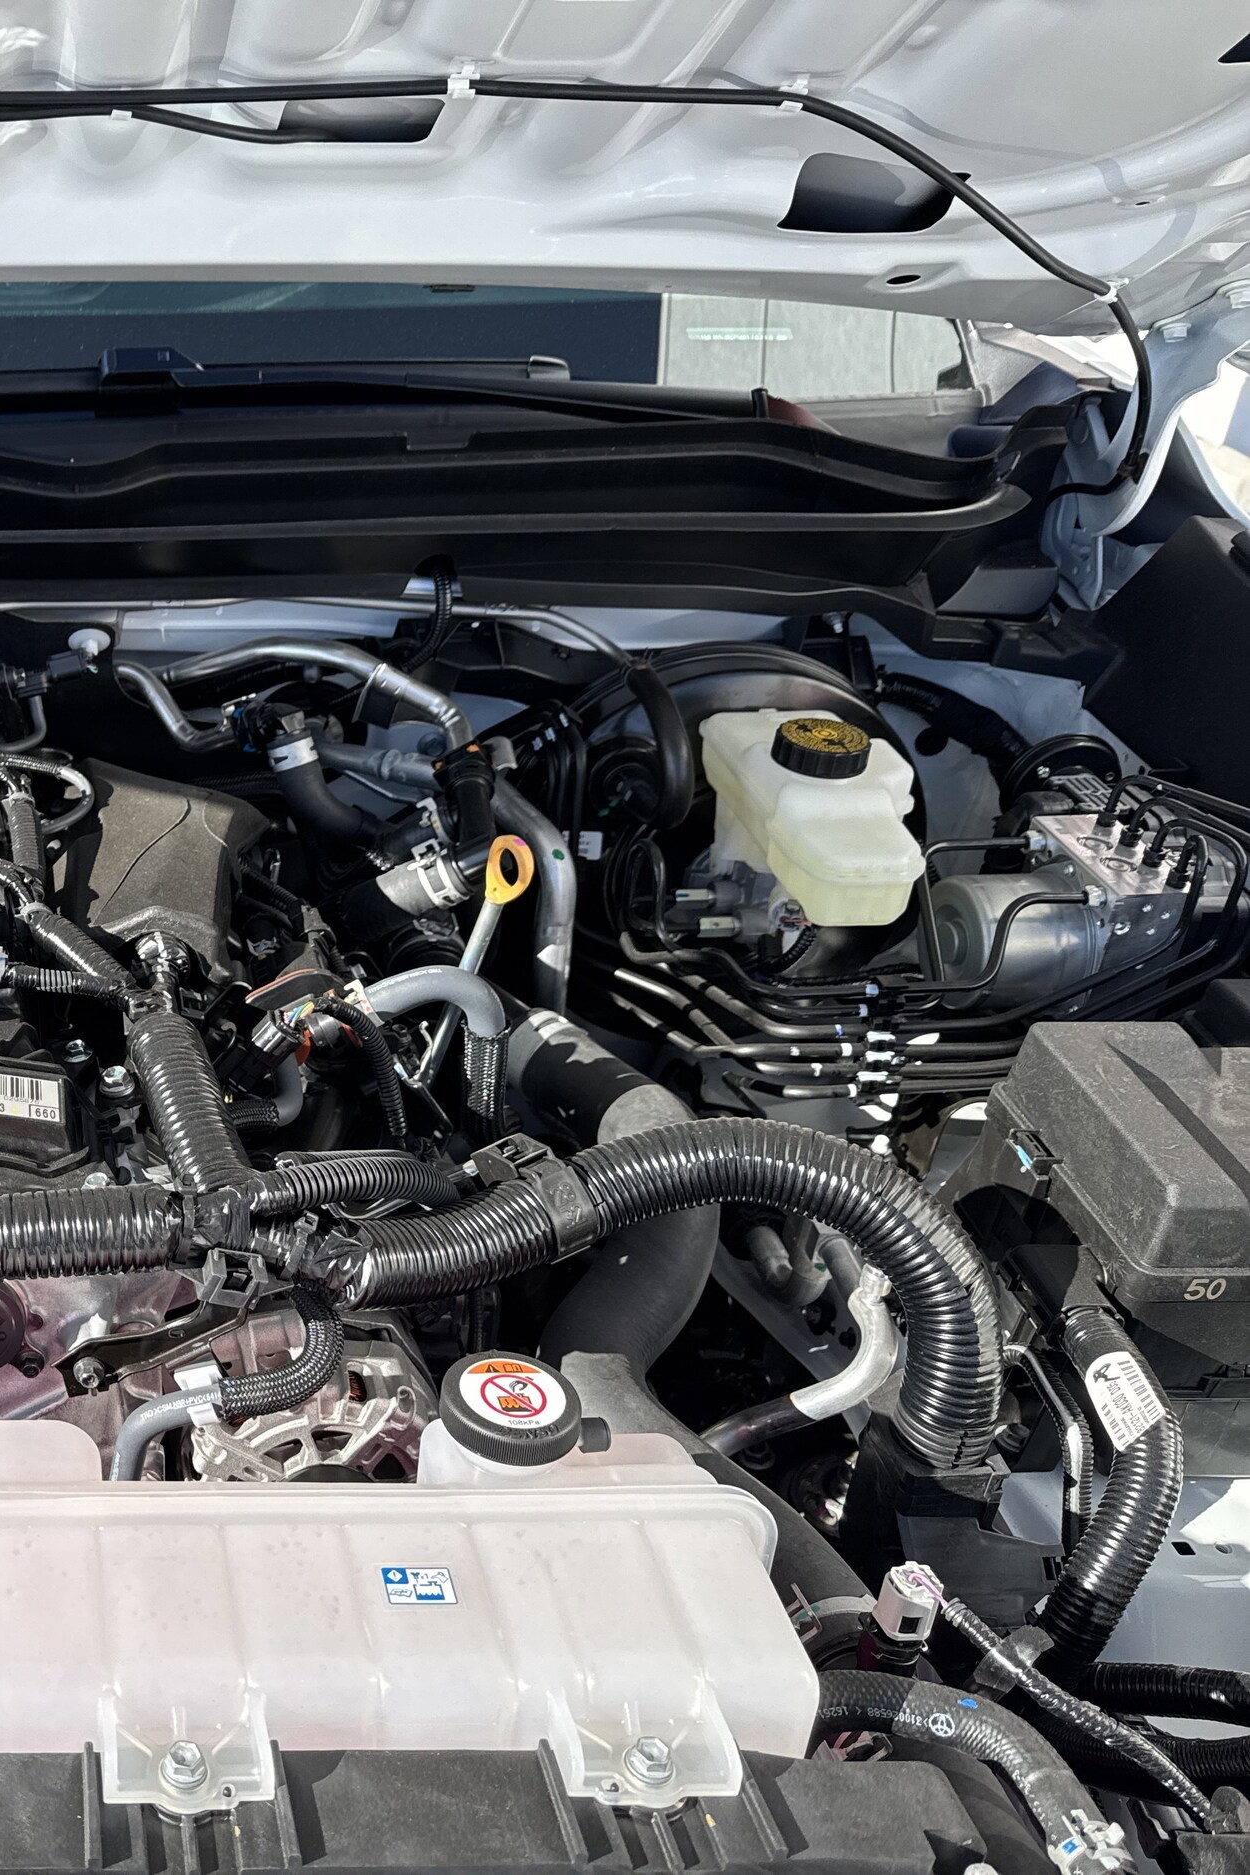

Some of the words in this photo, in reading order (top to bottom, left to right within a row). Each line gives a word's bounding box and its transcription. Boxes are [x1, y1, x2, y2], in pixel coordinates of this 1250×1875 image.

[35, 1108, 56, 1119] 660
[1183, 1278, 1227, 1301] 50
[507, 1418, 541, 1427] 108kPa
